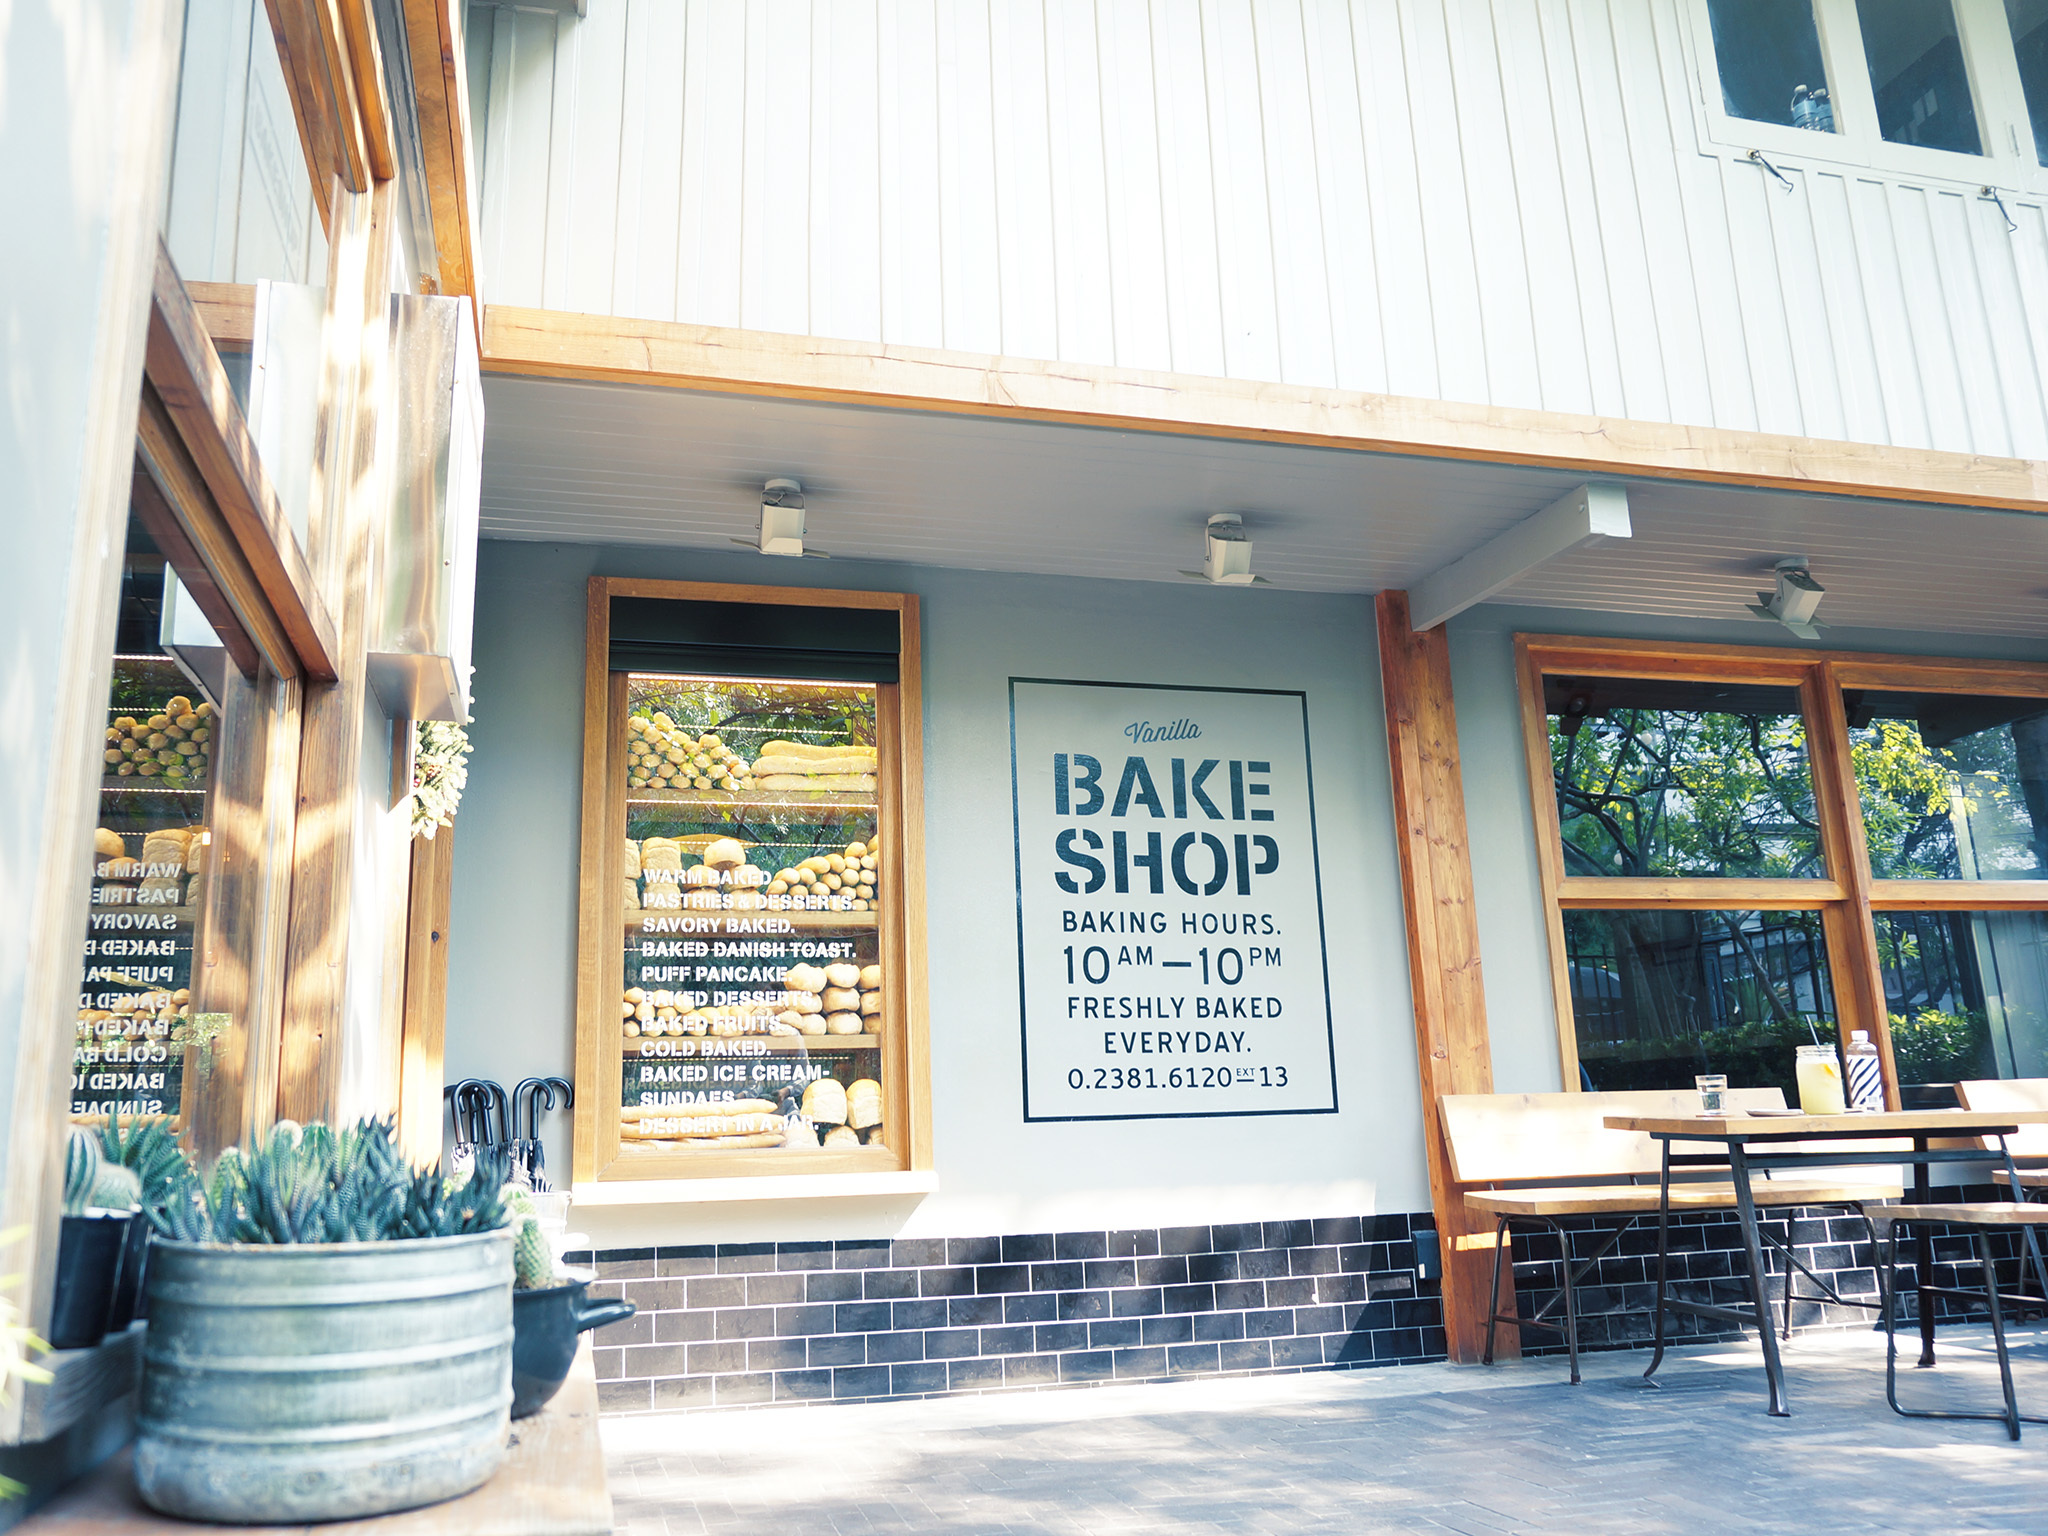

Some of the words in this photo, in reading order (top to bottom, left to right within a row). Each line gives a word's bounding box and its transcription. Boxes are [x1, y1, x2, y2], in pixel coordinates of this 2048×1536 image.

[1124, 719, 1202, 744] Vanilla
[1053, 753, 1275, 822] BAKE
[1054, 828, 1280, 896] SHOP
[643, 868, 702, 884] WARM
[708, 869, 772, 885] BAKED
[643, 893, 734, 909] PASTRIES
[737, 894, 751, 909] &
[755, 894, 857, 910] DESSERTS.
[643, 917, 721, 933] SAVORY
[726, 918, 796, 933] BAKED.
[1062, 910, 1167, 934] BAKING
[1181, 912, 1282, 935] HOURS.
[642, 941, 709, 957] BAKED
[713, 941, 785, 958] DANISH
[789, 942, 857, 958] TOAST.
[642, 966, 691, 982] PUFF
[696, 966, 793, 982] PANCAKE.
[642, 990, 708, 1007] BAKED
[1068, 997, 1185, 1019] FRESHLY
[1196, 997, 1283, 1019] BAKED
[641, 1015, 708, 1032] BAKED
[641, 1040, 696, 1057] COLD
[701, 1040, 771, 1056] BAKED.
[1104, 1031, 1252, 1054] EVERYDAY.
[641, 1065, 708, 1082] BAKED
[713, 1065, 747, 1082] ICE
[751, 1064, 829, 1082] CREAM-
[639, 1115, 729, 1135] DESSERT
[735, 1115, 755, 1132] IN
[759, 1115, 773, 1132] A
[777, 1114, 818, 1132] JAR.
